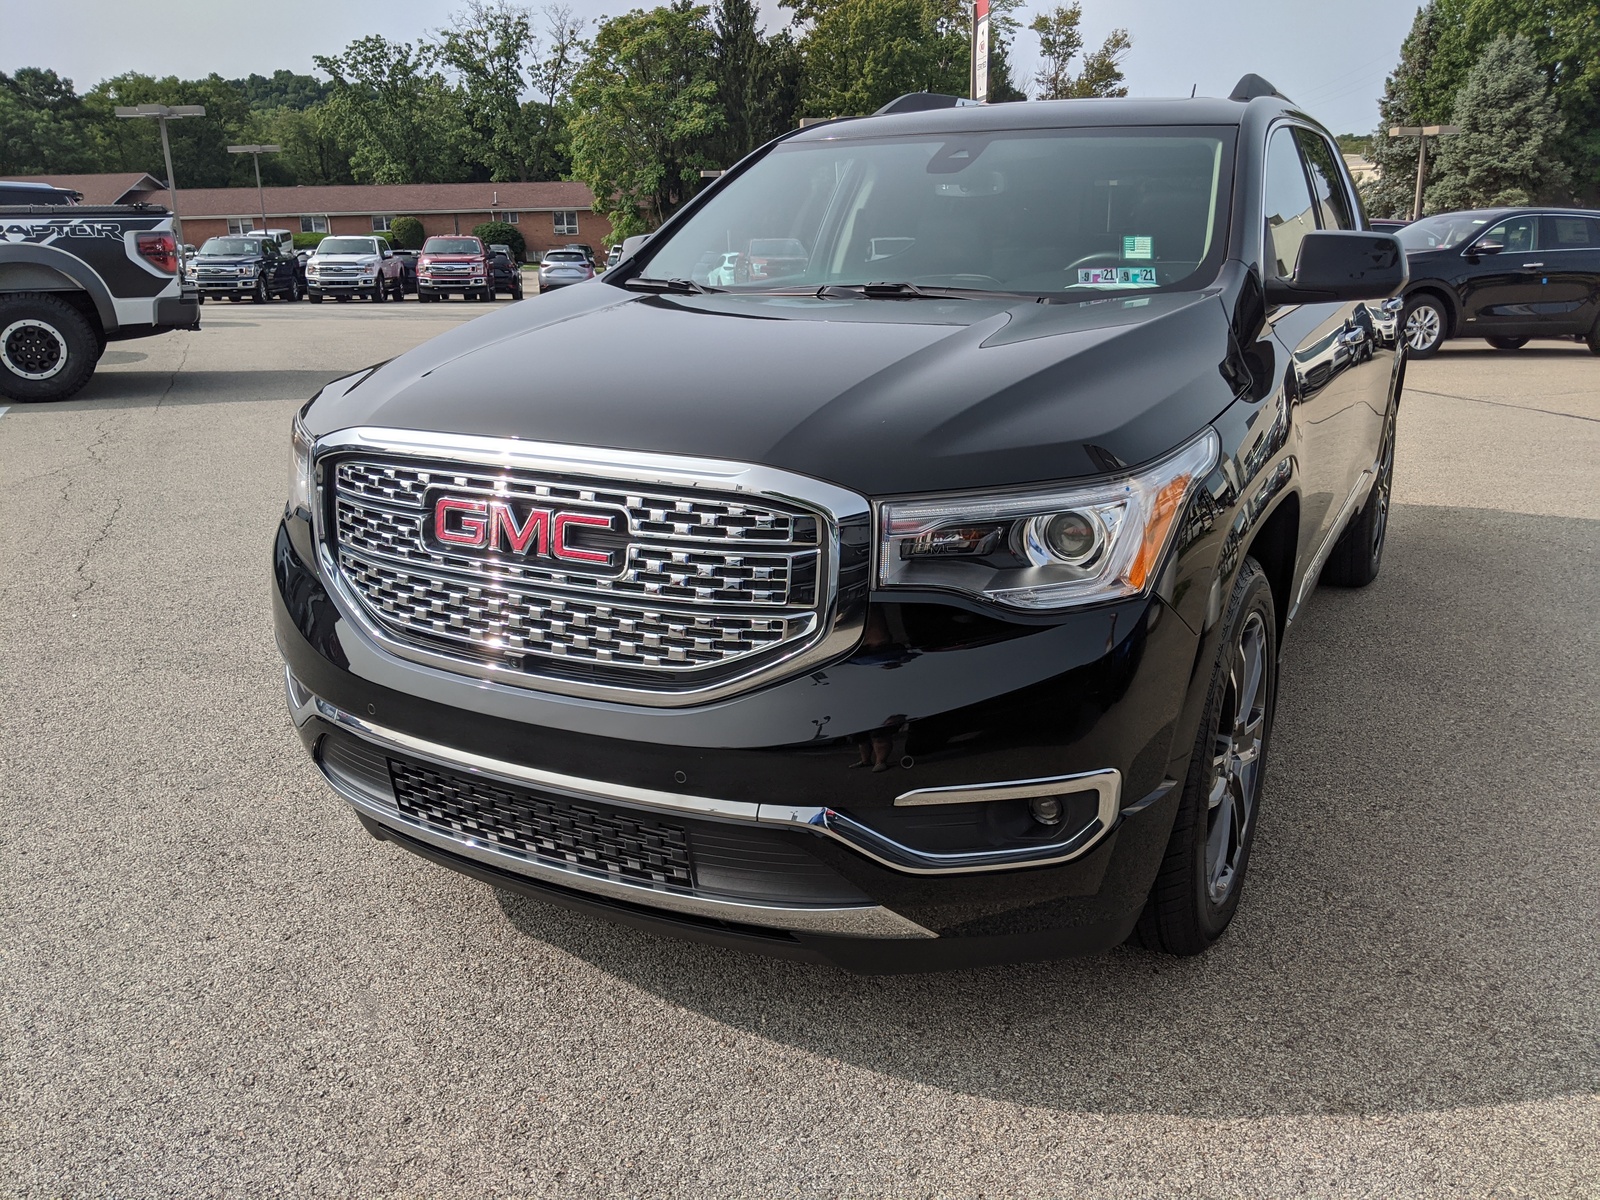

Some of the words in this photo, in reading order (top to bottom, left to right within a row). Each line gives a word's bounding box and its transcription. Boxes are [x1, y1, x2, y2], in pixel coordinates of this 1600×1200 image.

[1103, 269, 1115, 280] 21
[1143, 269, 1154, 280] 21
[434, 497, 616, 567] GMC
